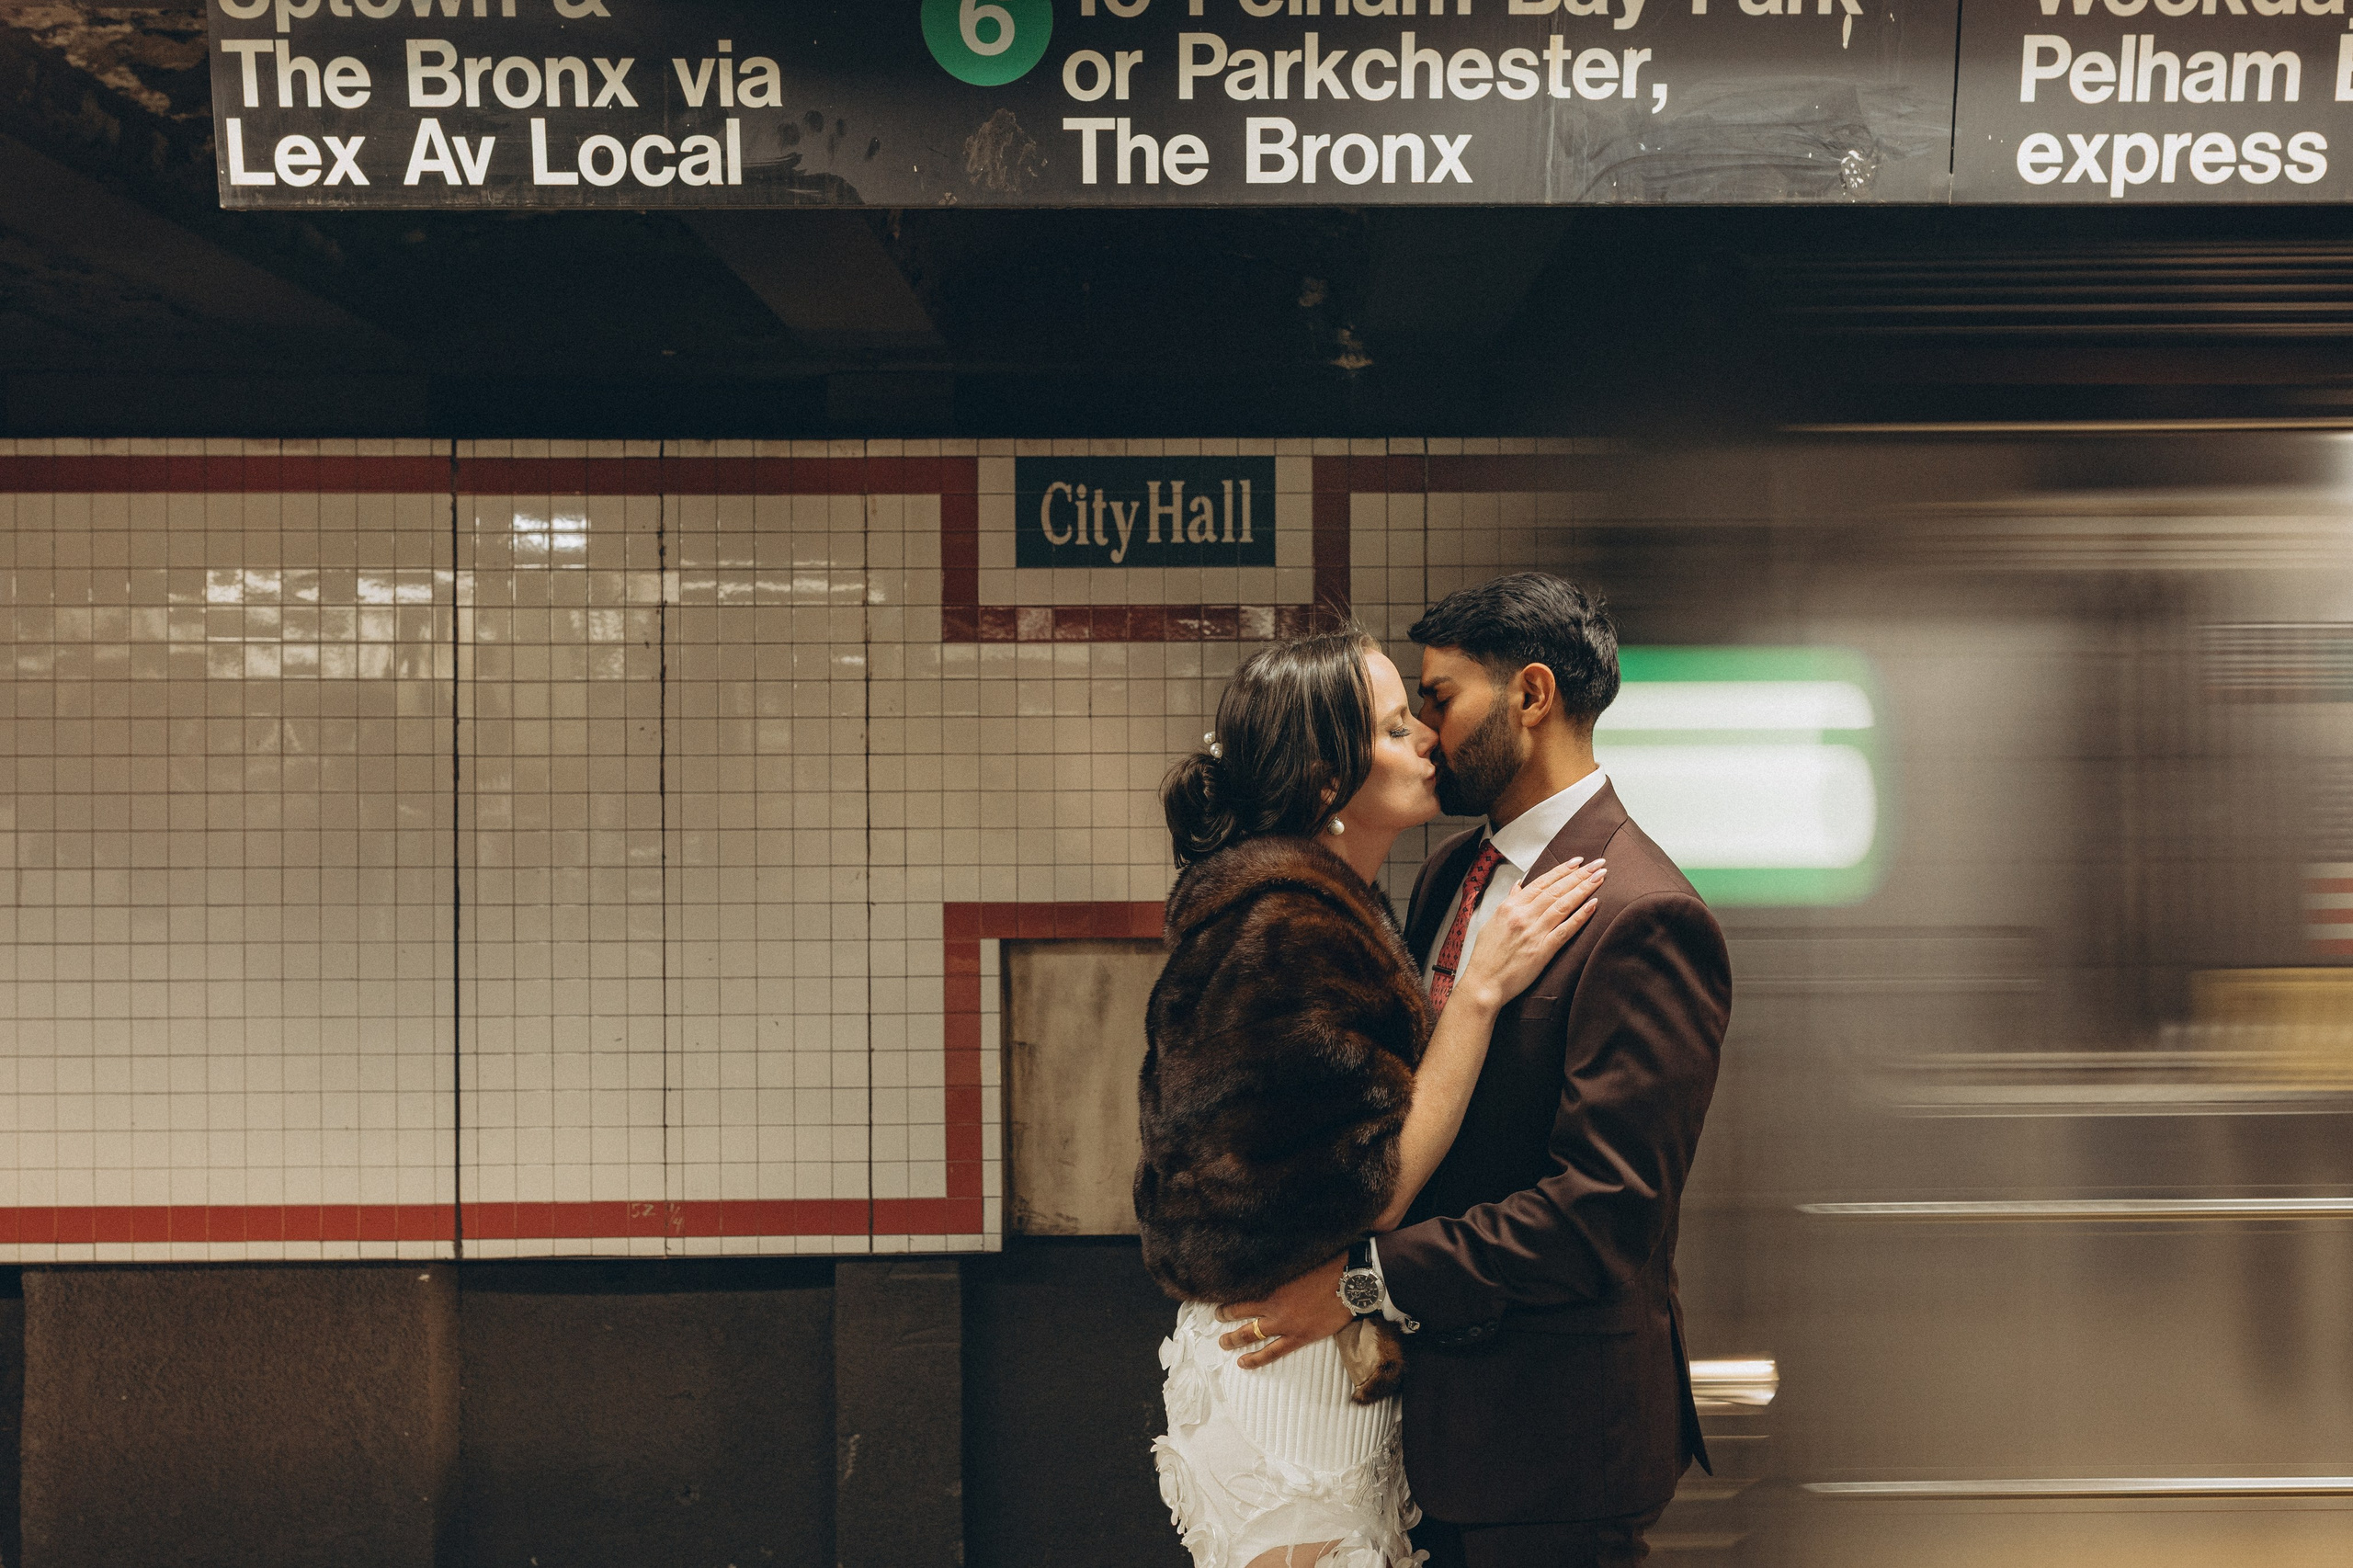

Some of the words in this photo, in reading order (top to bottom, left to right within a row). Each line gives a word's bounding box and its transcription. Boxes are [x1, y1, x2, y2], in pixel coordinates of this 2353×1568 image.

[959, 0, 1015, 56] 6
[221, 40, 371, 108] The
[406, 40, 639, 108] Bronx
[673, 40, 783, 108] via
[1063, 50, 1142, 101] or
[1179, 32, 1667, 112] Parkchester,
[2020, 34, 2302, 104] Pelham
[226, 118, 369, 187] Lex
[404, 118, 495, 186] Av
[530, 118, 743, 187] Local
[1063, 117, 1210, 185] The
[1245, 117, 1473, 185] Bronx
[2017, 131, 2328, 198] express
[1040, 482, 1140, 563] City
[1147, 479, 1254, 543] Hall
